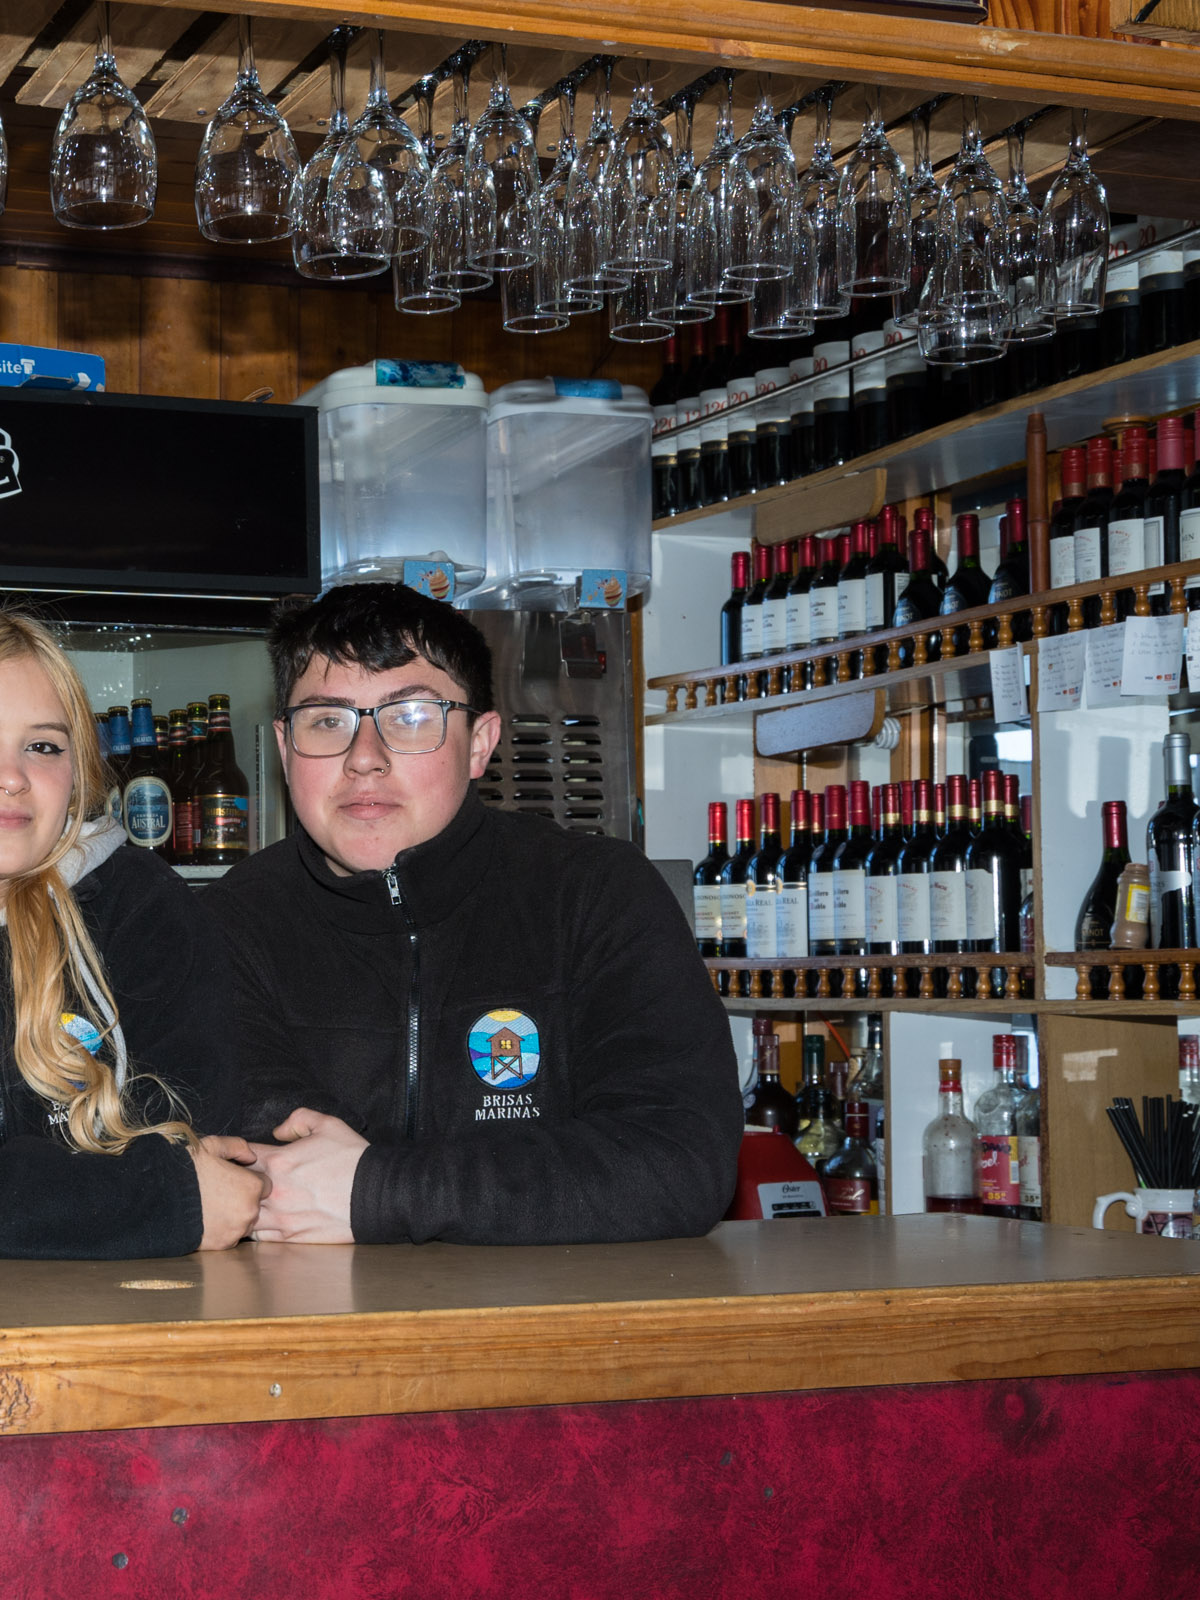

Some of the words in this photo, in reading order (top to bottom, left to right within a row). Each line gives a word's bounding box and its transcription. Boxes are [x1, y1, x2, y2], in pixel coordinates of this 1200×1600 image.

[1138, 223, 1156, 246] 20
[1108, 240, 1128, 258] 20
[131, 815, 166, 829] AUSTRAL
[755, 898, 773, 906] REAL
[782, 897, 799, 905] REAL
[483, 1093, 533, 1108] BRISAS
[475, 1106, 541, 1121] MARINAS
[782, 1184, 801, 1194] Oster
